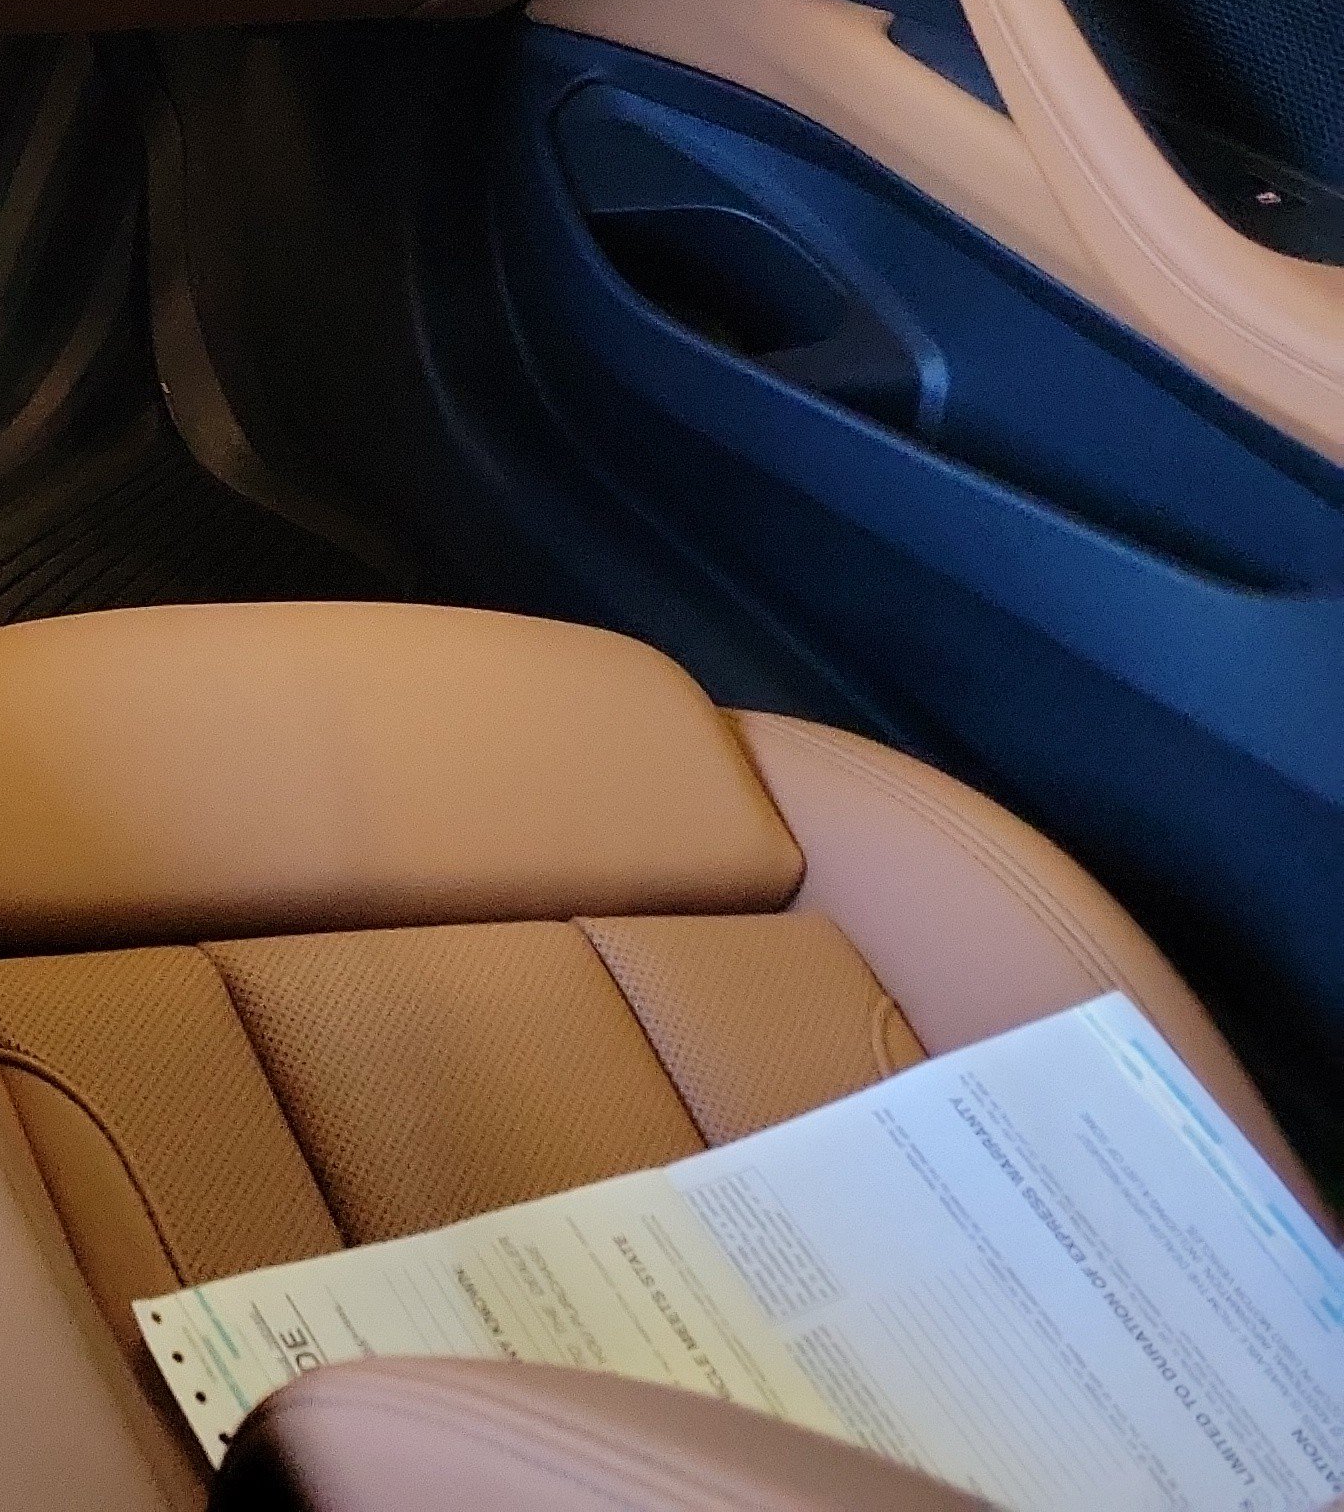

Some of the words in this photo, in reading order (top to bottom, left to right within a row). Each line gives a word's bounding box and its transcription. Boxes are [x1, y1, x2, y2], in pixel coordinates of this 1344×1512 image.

[947, 1095, 1026, 1186] WARRANTY
[1020, 1186, 1088, 1263] EXPRESS
[1081, 1265, 1108, 1291] OF
[1102, 1291, 1179, 1382] DURATION
[1172, 1383, 1198, 1411] TO
[1193, 1412, 1256, 1485] LIMITED
